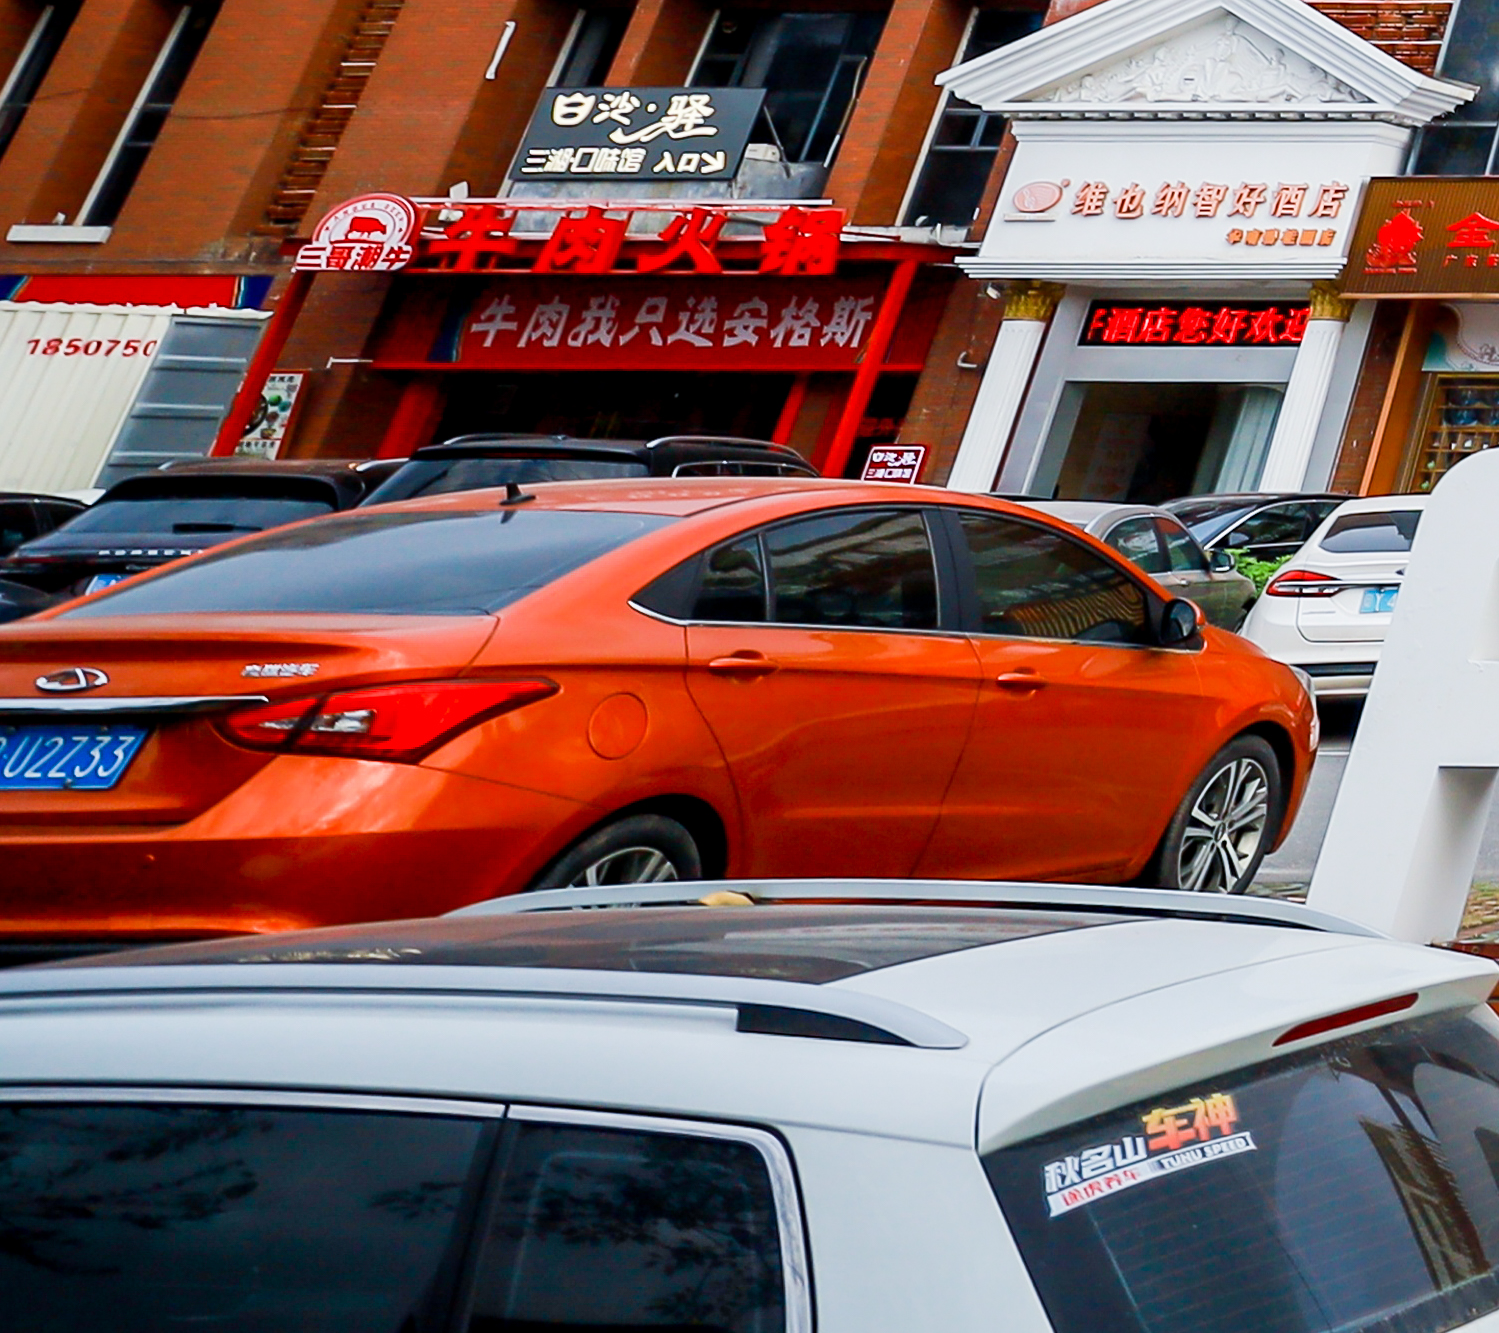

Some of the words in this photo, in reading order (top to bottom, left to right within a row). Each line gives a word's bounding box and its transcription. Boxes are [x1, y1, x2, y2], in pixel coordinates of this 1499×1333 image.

[1071, 180, 1350, 220] 维也纳智好酒店
[429, 204, 846, 276] 牛肉火锅
[471, 295, 875, 348] 牛肉我只选安格斯
[1141, 1092, 1239, 1151] 车神
[1043, 1135, 1149, 1194] 秋名山
